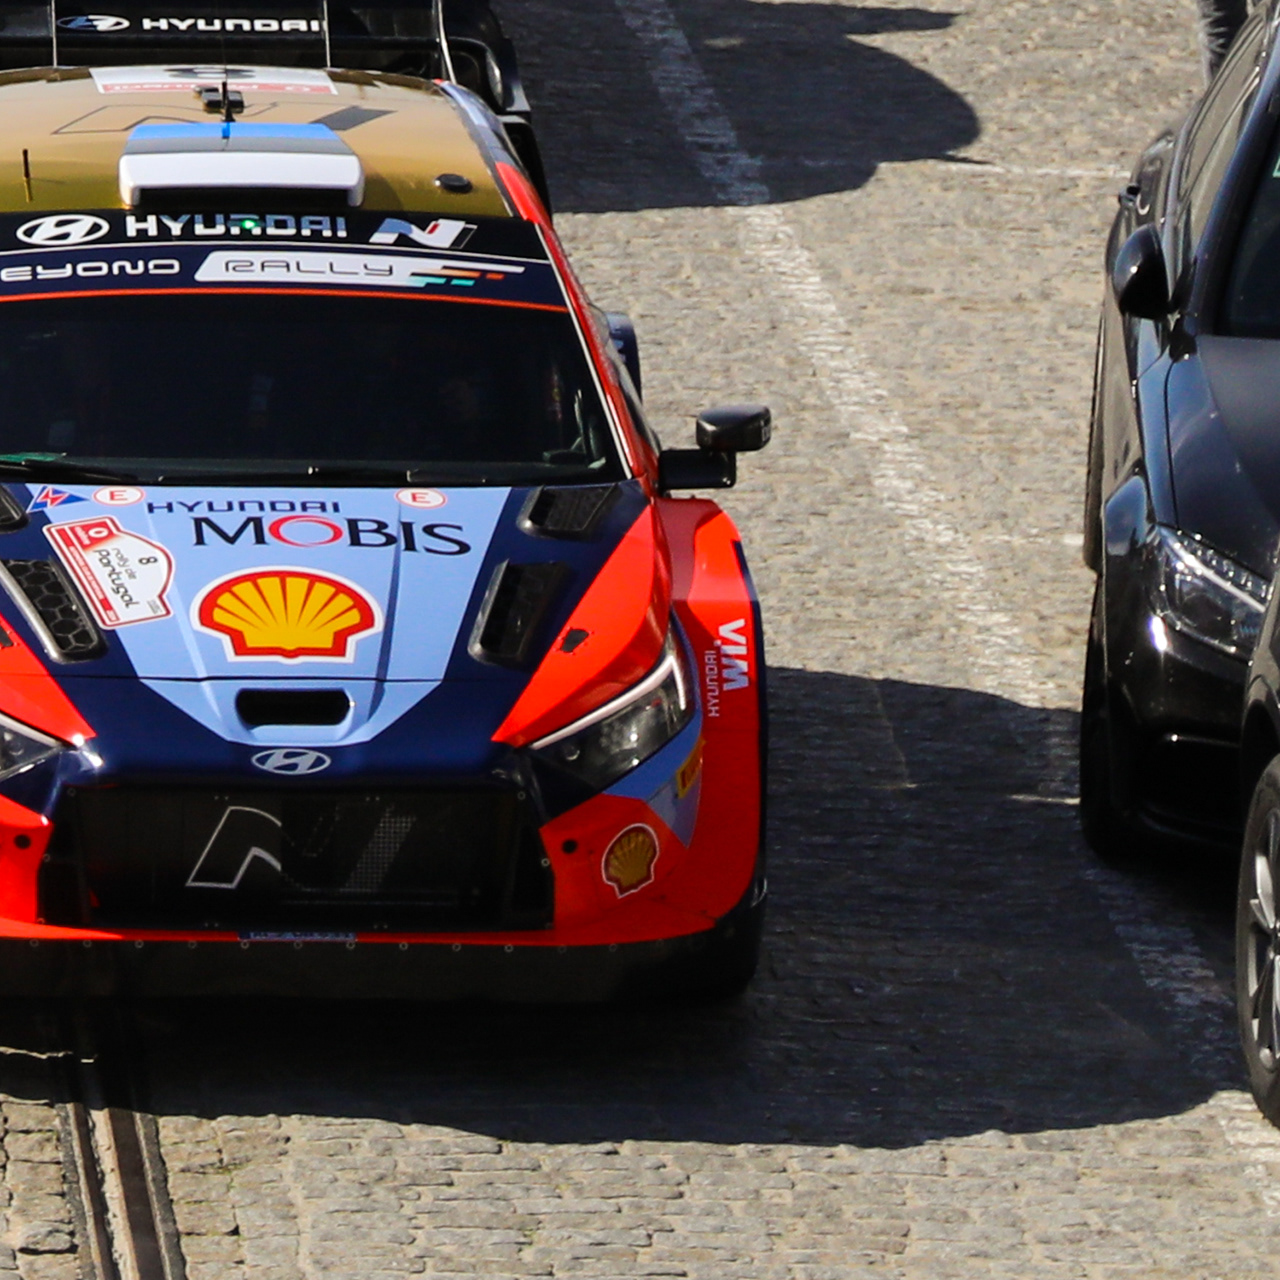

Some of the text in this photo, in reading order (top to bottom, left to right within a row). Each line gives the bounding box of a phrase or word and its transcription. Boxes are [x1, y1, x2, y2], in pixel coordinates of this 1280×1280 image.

[142, 17, 321, 33] HYUNDAI
[125, 214, 348, 239] HYUNDAI
[224, 260, 394, 279] RALLY
[147, 500, 340, 515] HYUNDAI
[193, 515, 472, 556] MOBIS
[138, 556, 158, 566] 8
[92, 548, 139, 608] Portugal
[705, 650, 720, 717] HYUNDAI
